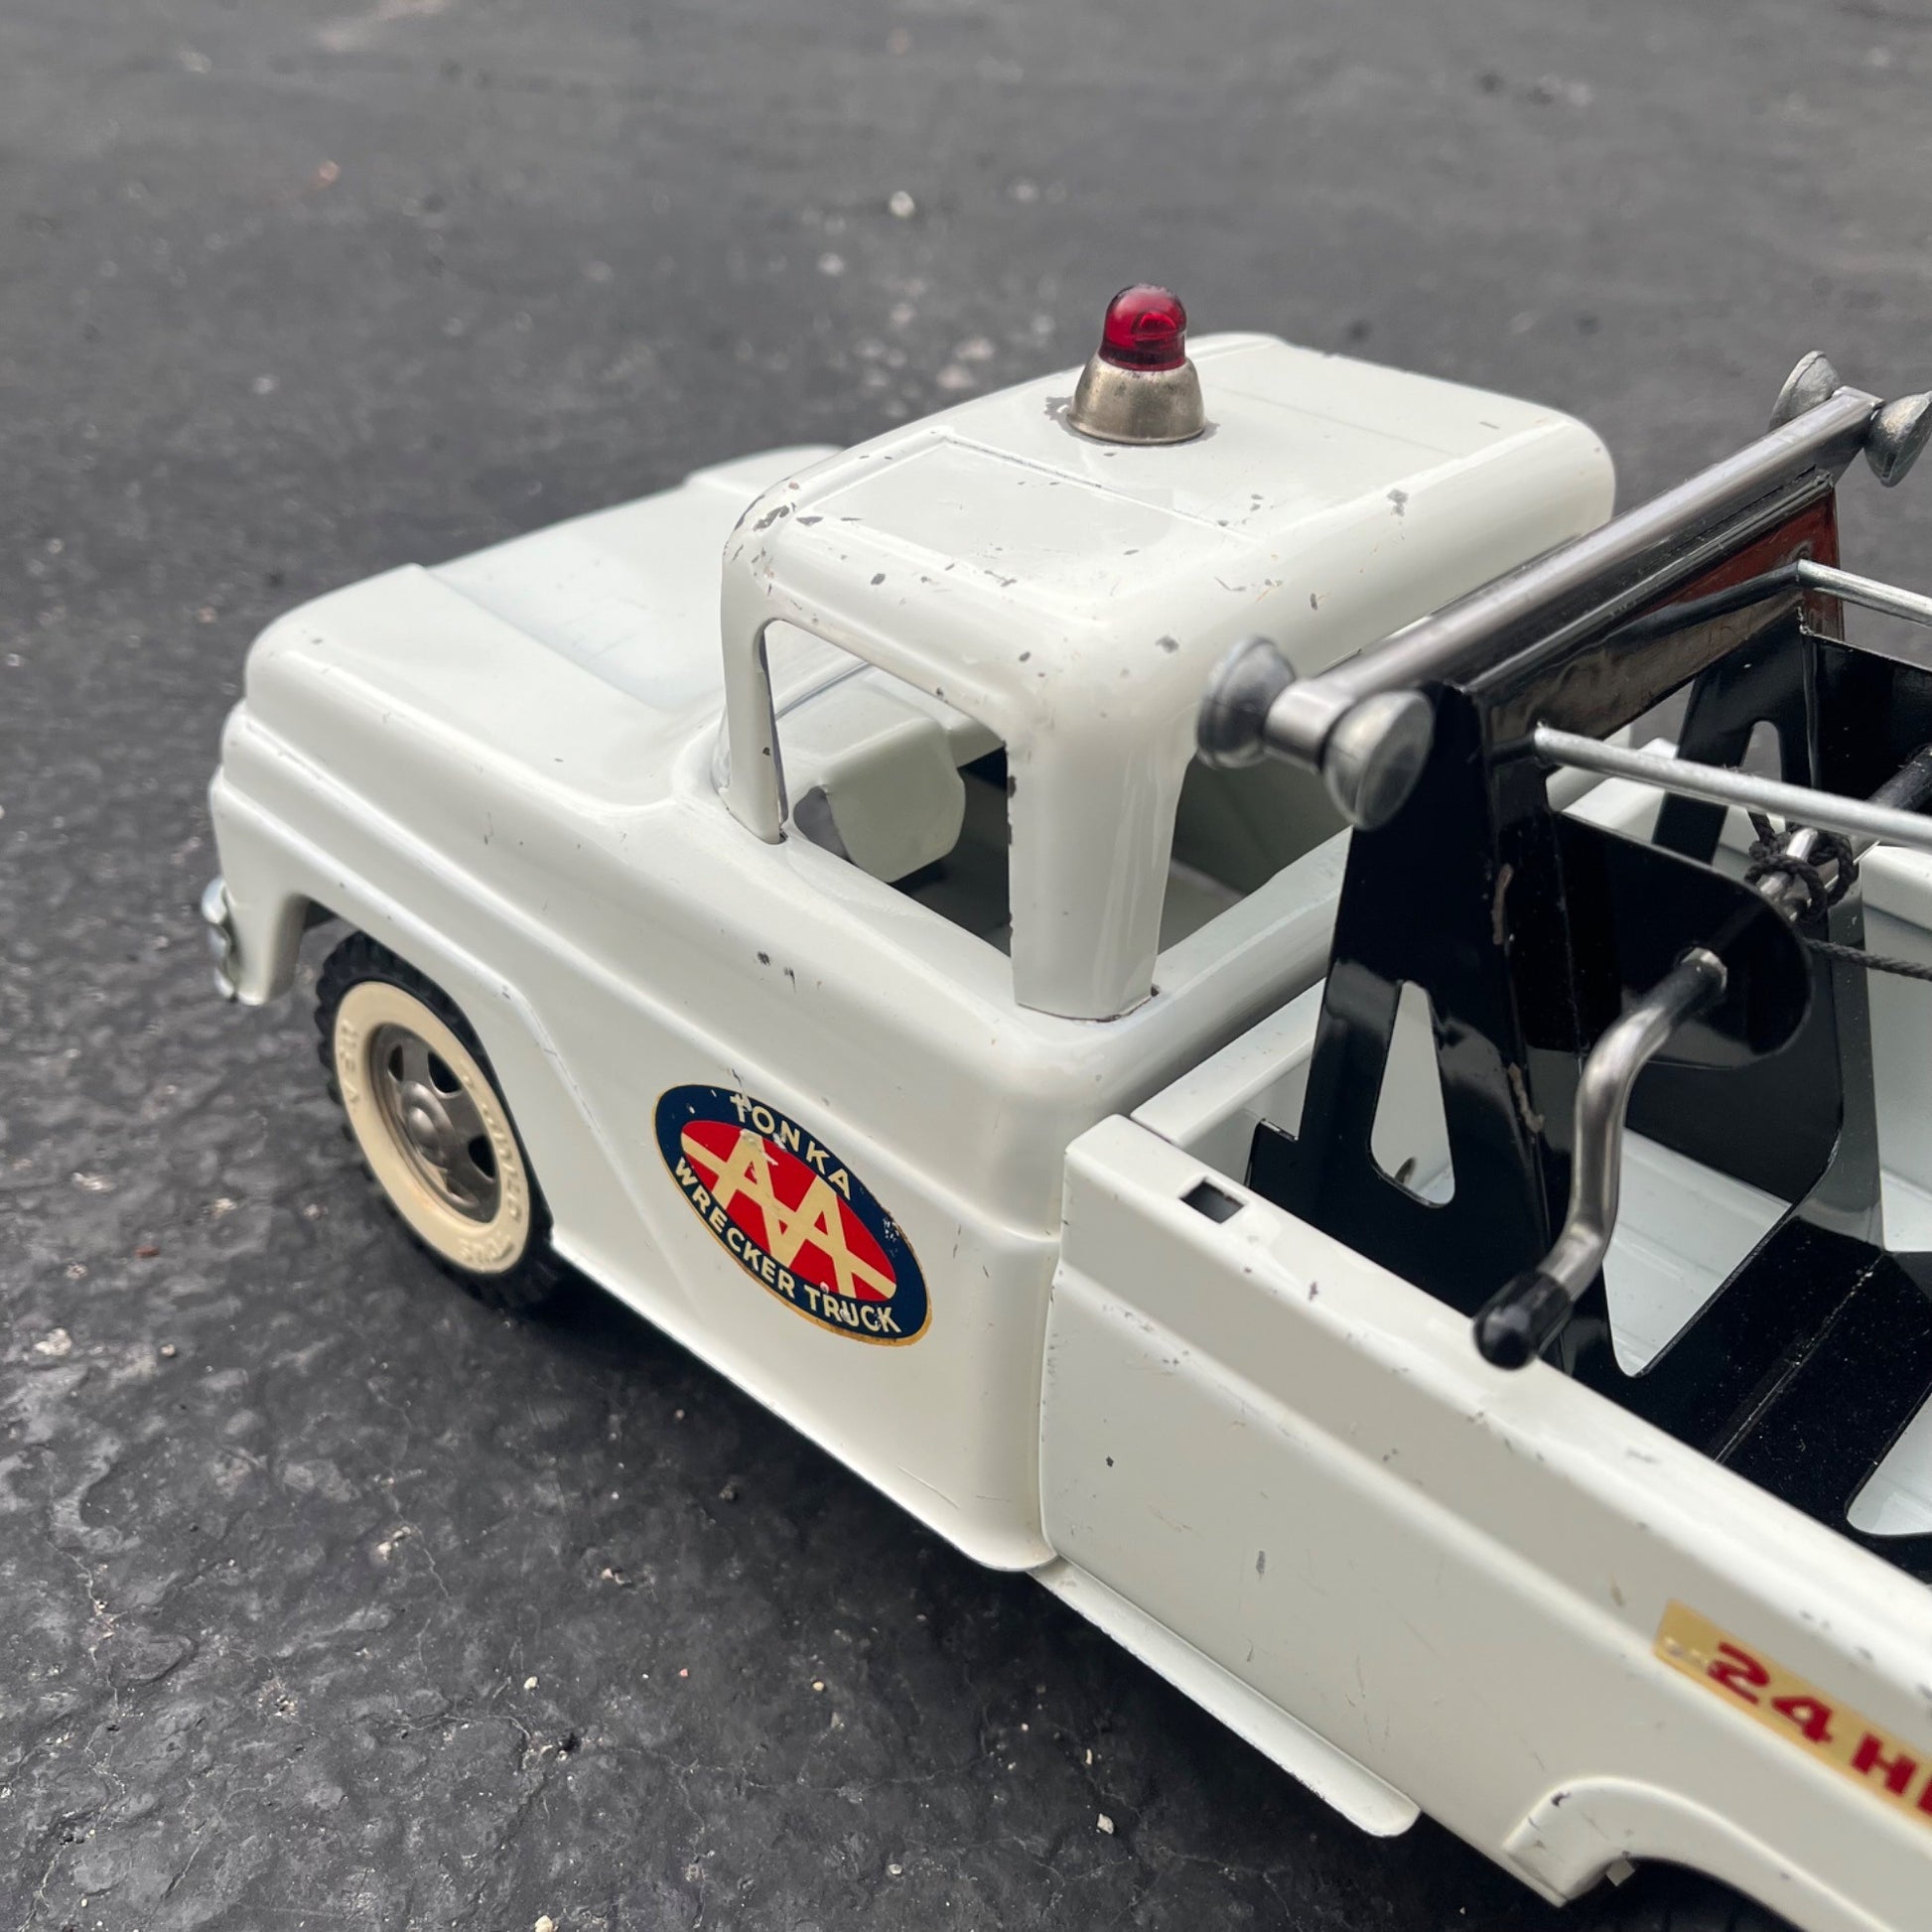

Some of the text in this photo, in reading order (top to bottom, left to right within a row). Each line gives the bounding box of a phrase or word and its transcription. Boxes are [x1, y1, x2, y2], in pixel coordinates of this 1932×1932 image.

[730, 1093, 851, 1200] TONKA
[675, 1158, 901, 1333] WRECKER TRUCK
[1707, 1641, 1833, 1744] 24
